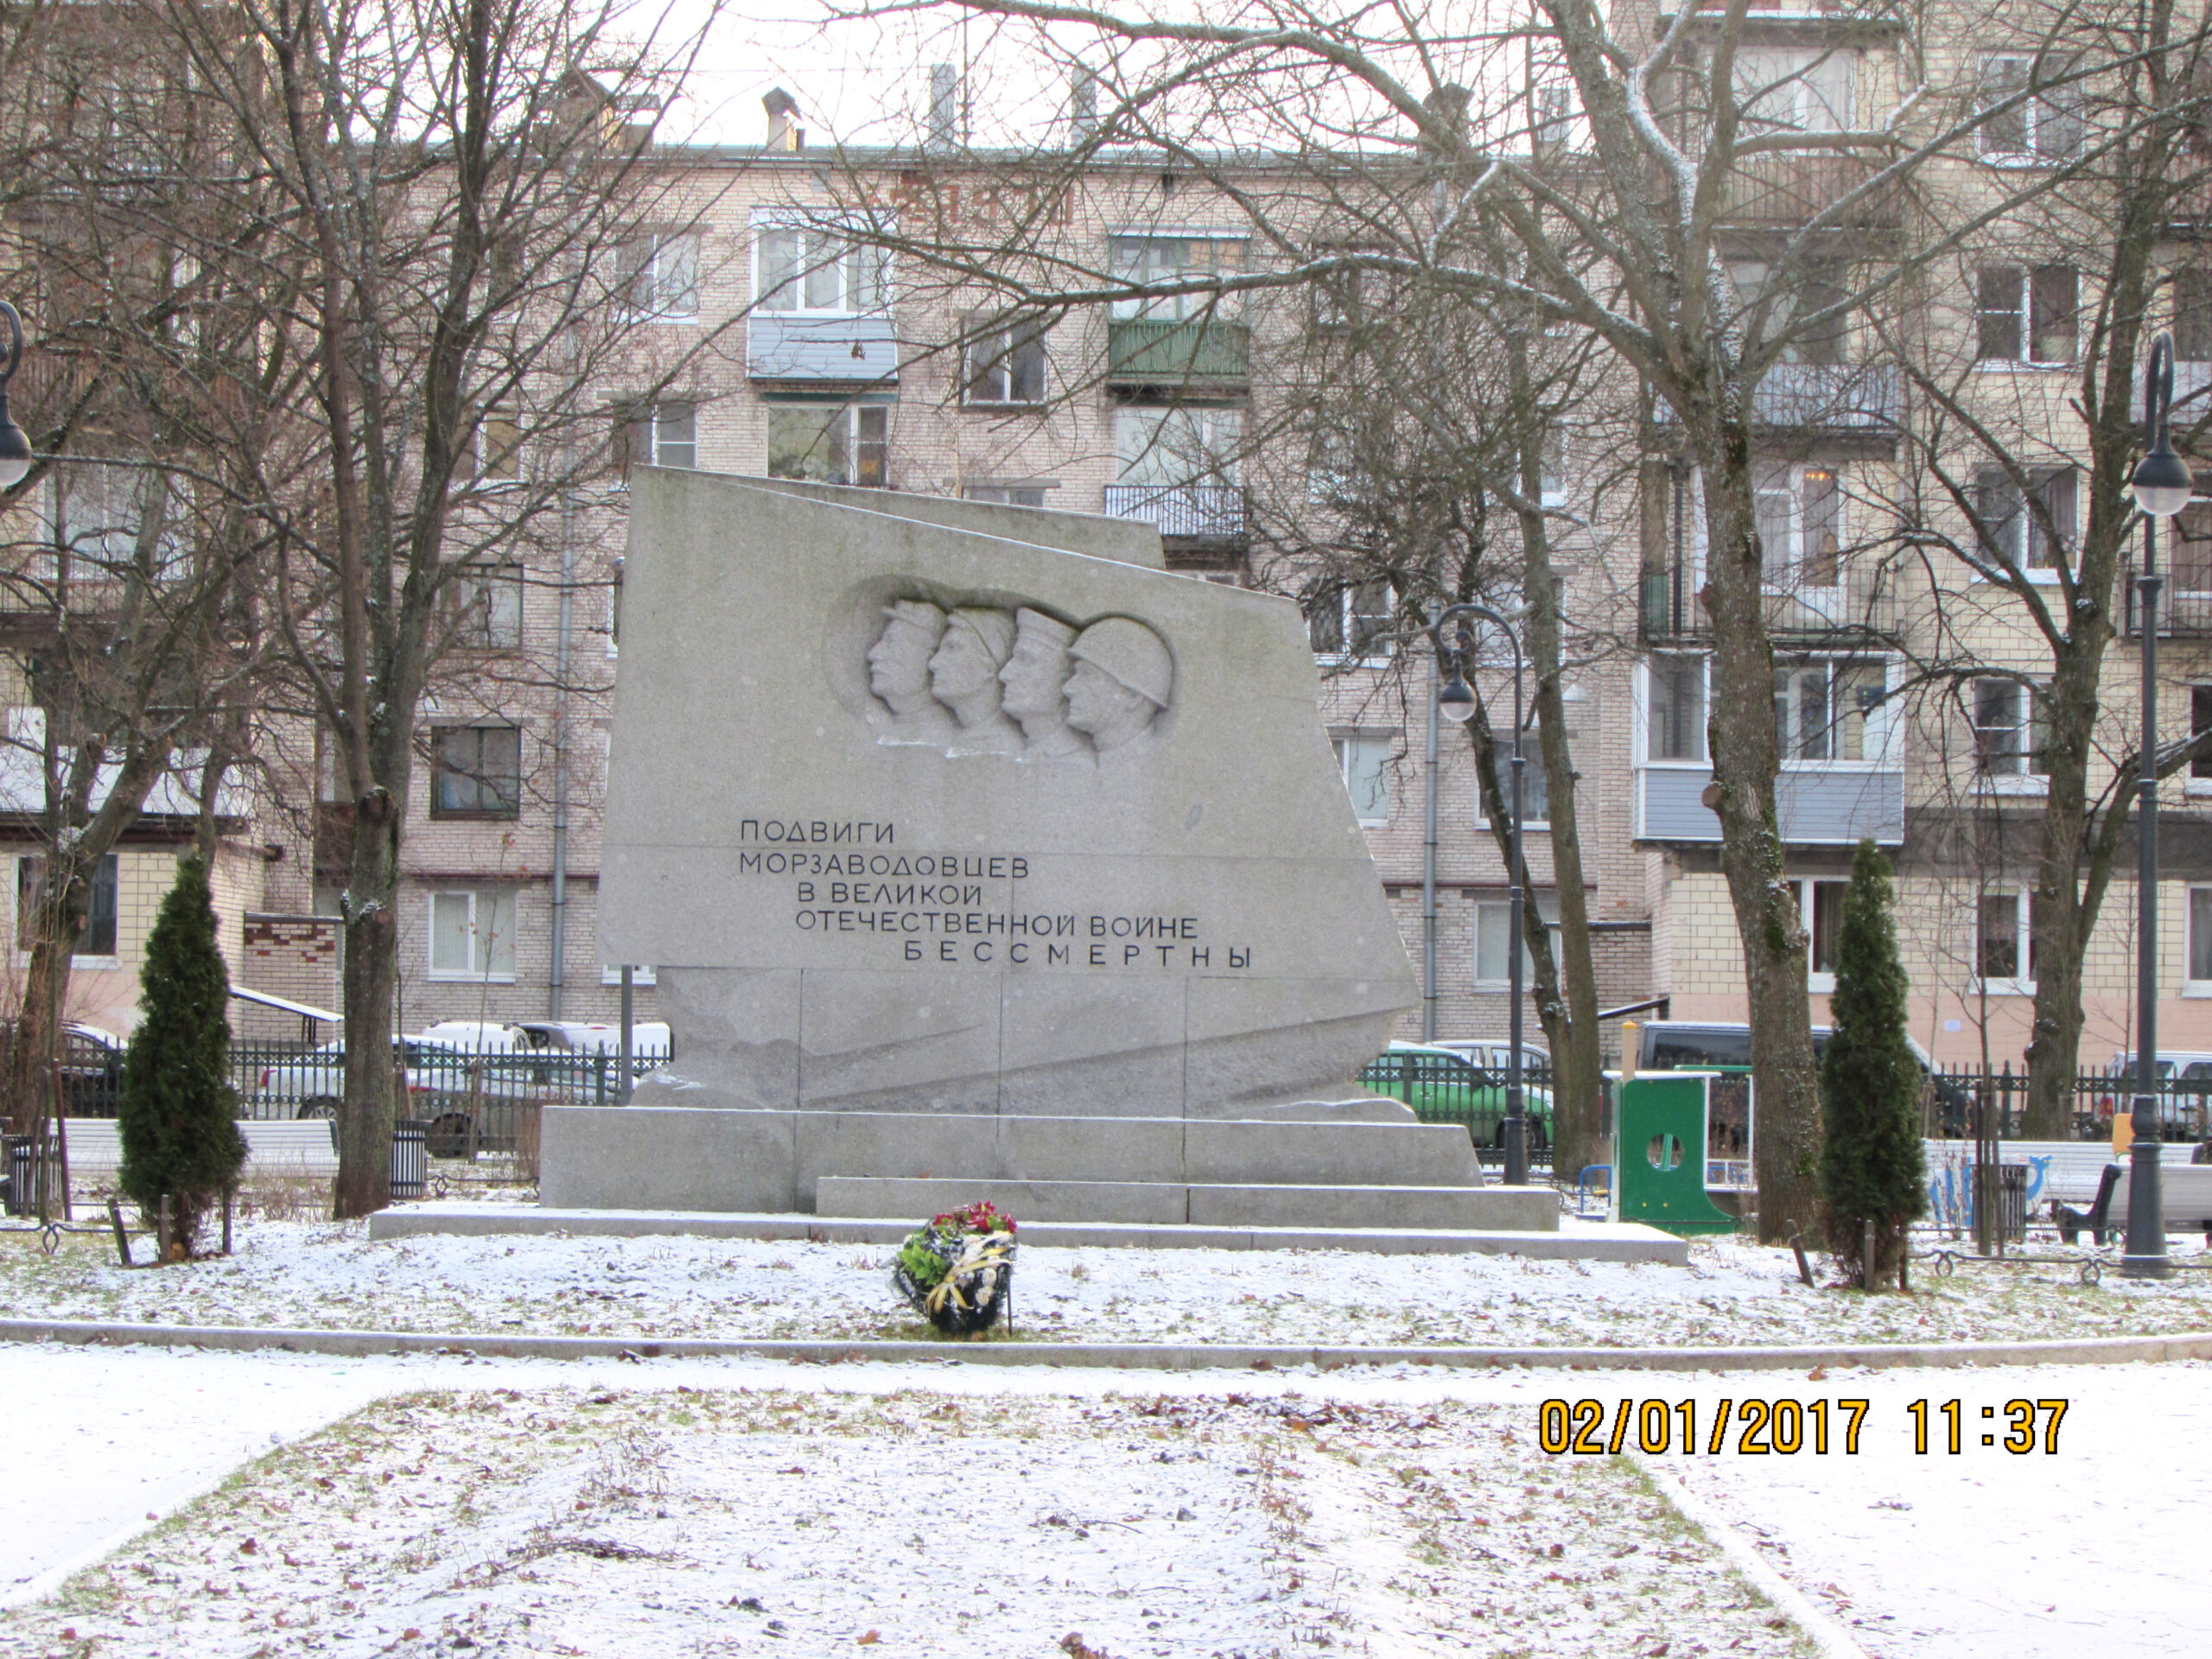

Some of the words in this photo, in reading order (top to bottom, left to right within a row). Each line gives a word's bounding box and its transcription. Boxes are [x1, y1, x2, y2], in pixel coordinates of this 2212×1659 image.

[740, 819, 893, 843] ПОДВИГИ
[740, 852, 1029, 879] МОРЗАВОДОВЦЕВ
[798, 881, 815, 903] В
[831, 882, 982, 906] ВЕЛИКОЙ
[796, 910, 1075, 937] ОТЕЧЕСТВЕННОЙ
[1090, 915, 1198, 939] ВОЙНЕ
[905, 940, 1250, 969] БЕССМЕРТНЫ
